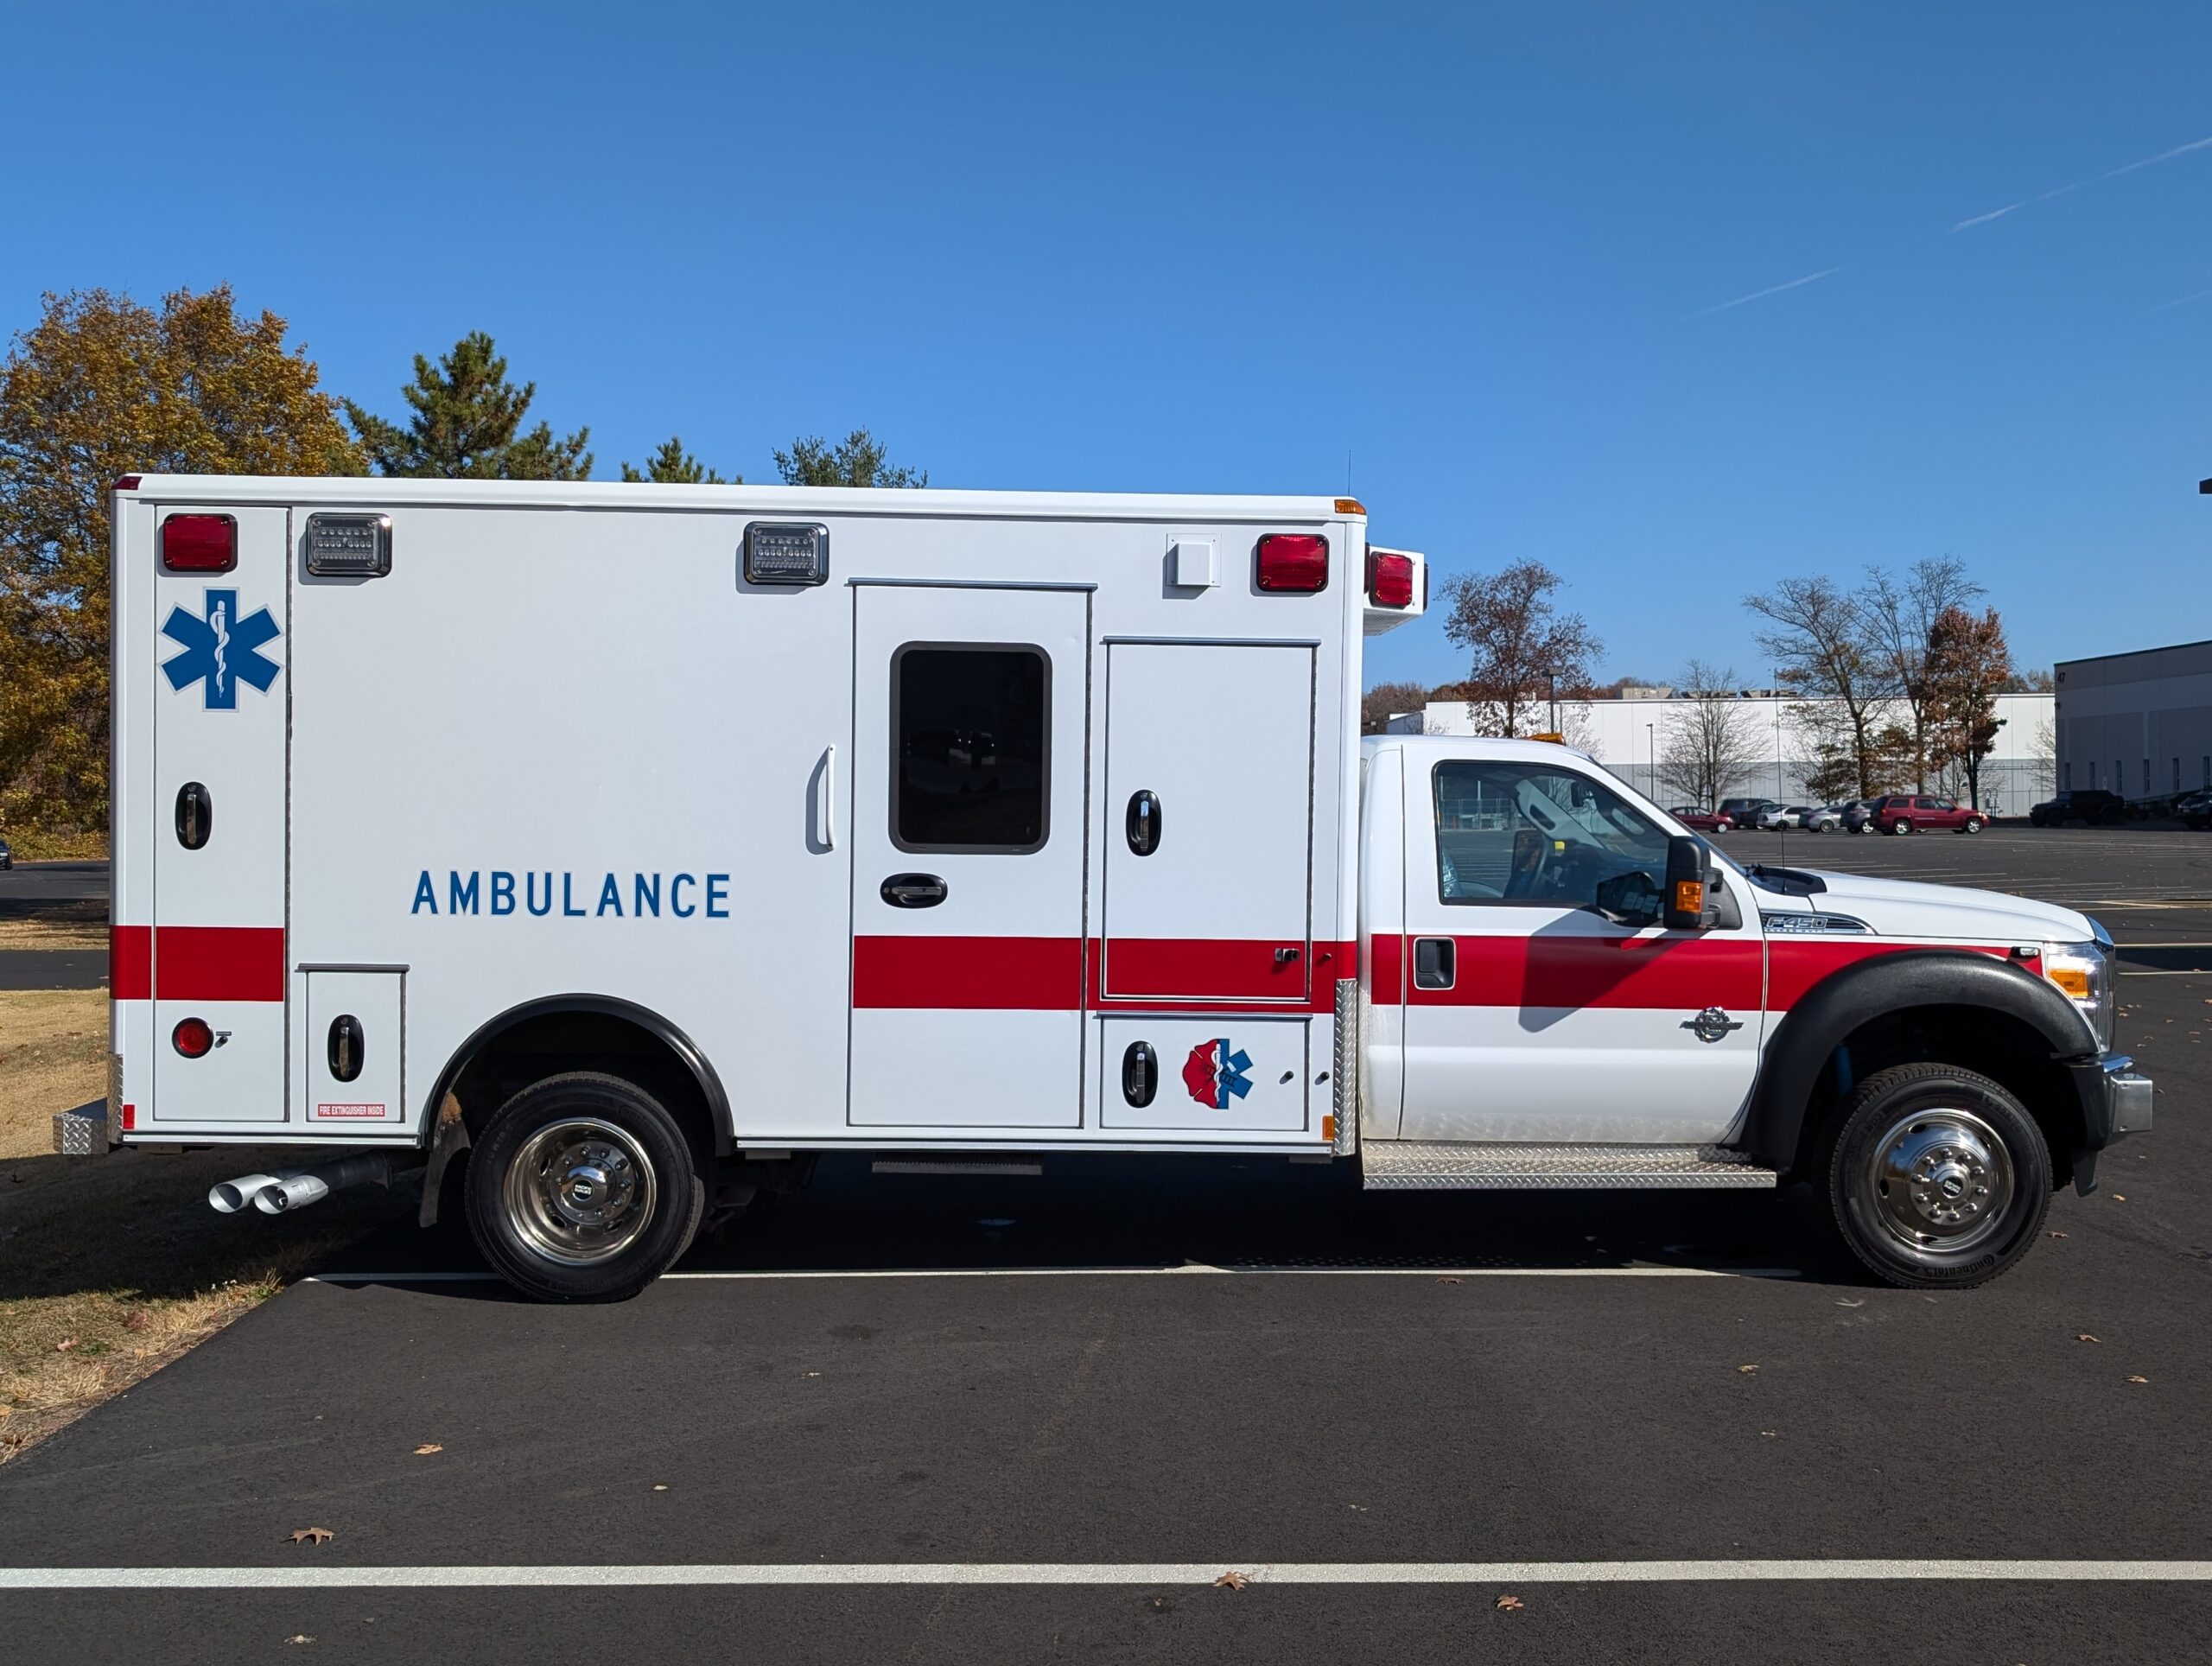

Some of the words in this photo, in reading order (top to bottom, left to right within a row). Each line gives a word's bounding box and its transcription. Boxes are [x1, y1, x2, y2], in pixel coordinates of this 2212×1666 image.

[410, 869, 730, 919] AMBULANCE
[320, 1106, 330, 1115] FIRE
[332, 1106, 366, 1115] EXTINGUISHER
[367, 1106, 383, 1115] INSIDE
